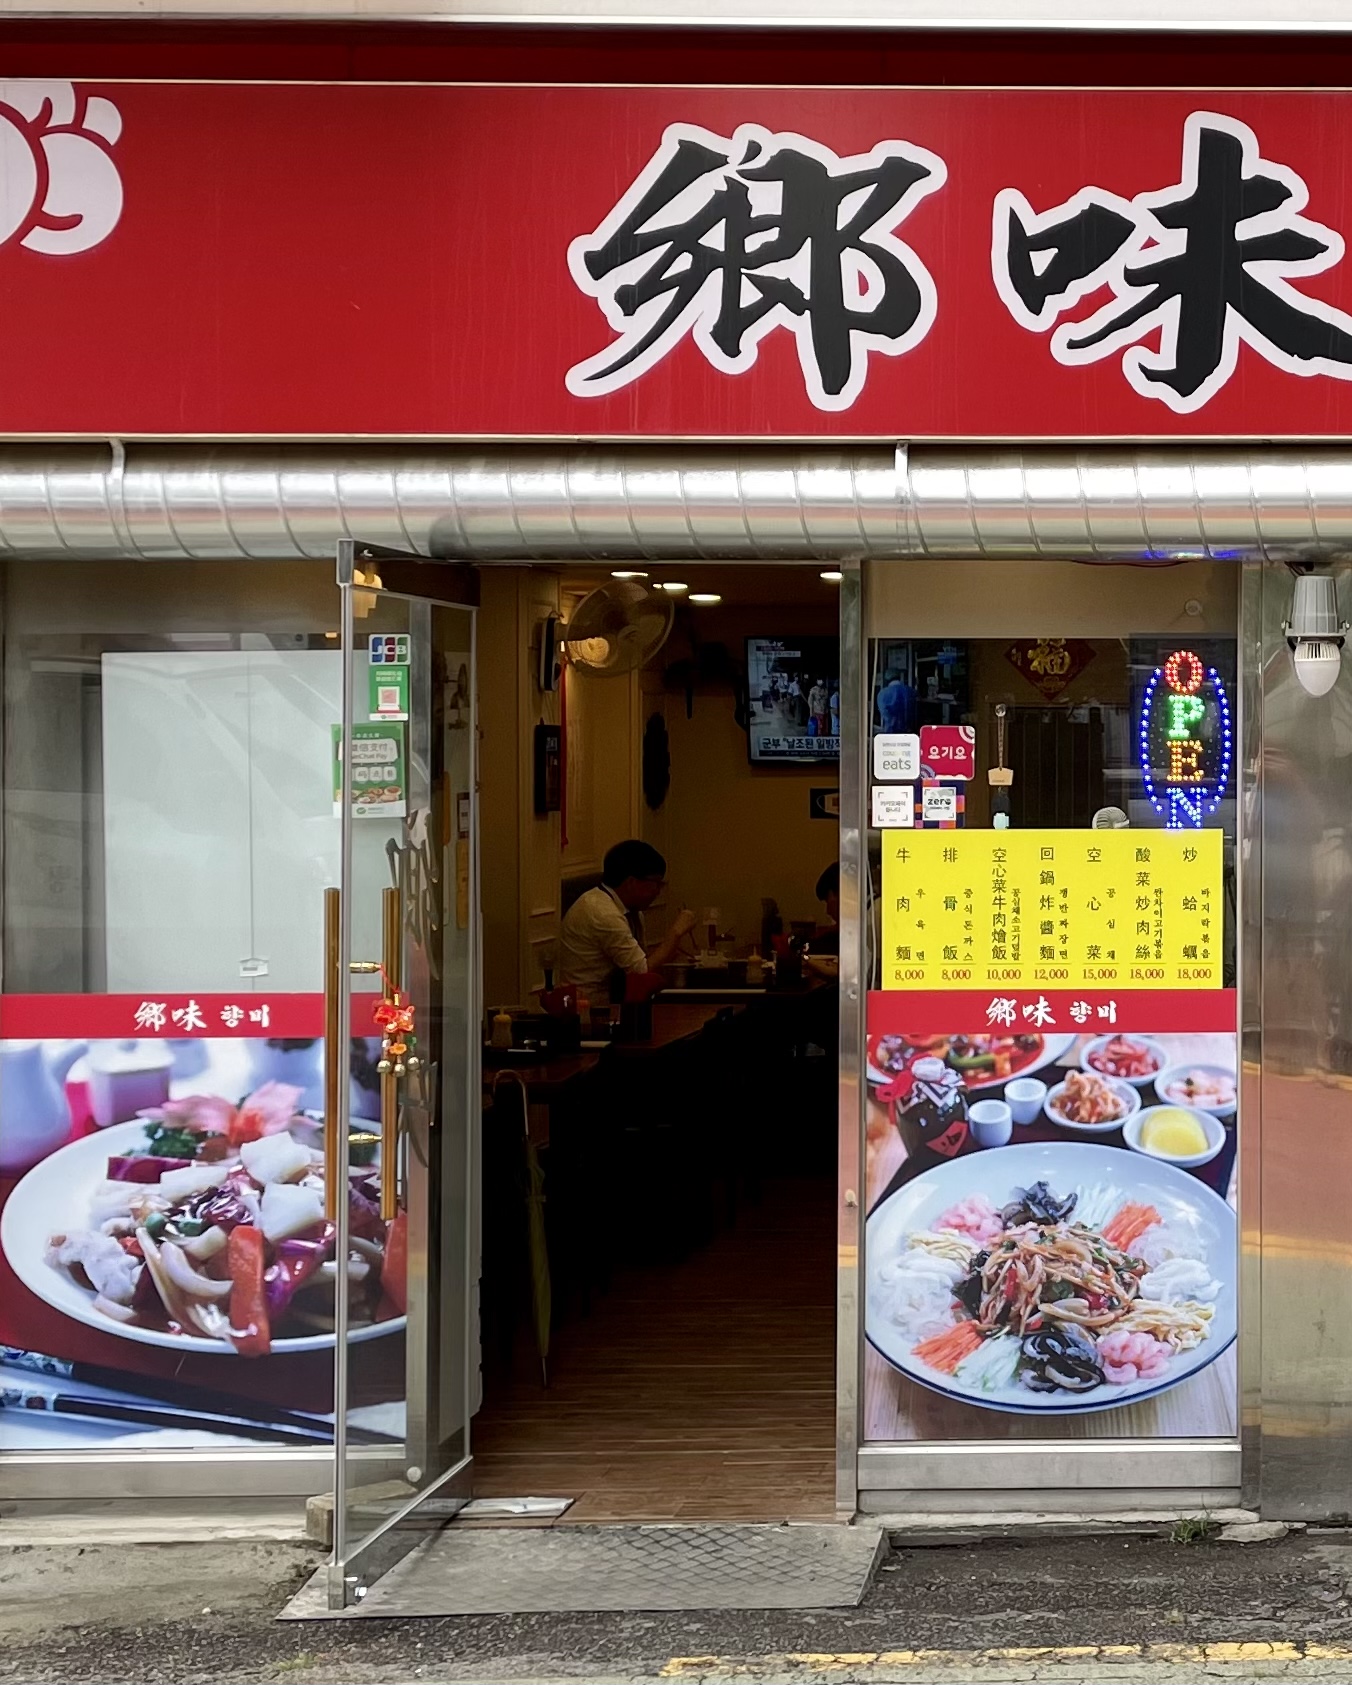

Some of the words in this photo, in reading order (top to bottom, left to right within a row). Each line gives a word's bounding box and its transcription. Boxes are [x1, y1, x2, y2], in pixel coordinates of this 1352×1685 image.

[1164, 650, 1208, 828] OPEN
[927, 746, 967, 760] 요기요
[882, 757, 911, 770] eats
[927, 798, 951, 806] zero
[896, 847, 911, 961] 牛肉麵
[942, 847, 958, 961] 排骨飯
[1039, 847, 1055, 960] 回鍋炸醬麵
[1086, 847, 1102, 960] 空心菜
[1135, 847, 1151, 960] 酸菜炒肉絲
[915, 888, 926, 961] 우육면
[894, 969, 925, 981] 8,000
[941, 969, 972, 981] 8,000
[986, 969, 1022, 981] 10,000
[1033, 968, 1069, 981] 12,000
[1082, 968, 1118, 981] 15,000
[1129, 968, 1165, 981] 18,000
[1176, 968, 1212, 981] 18,000
[220, 1004, 270, 1028] 향미
[1069, 1000, 1117, 1024] 향미
